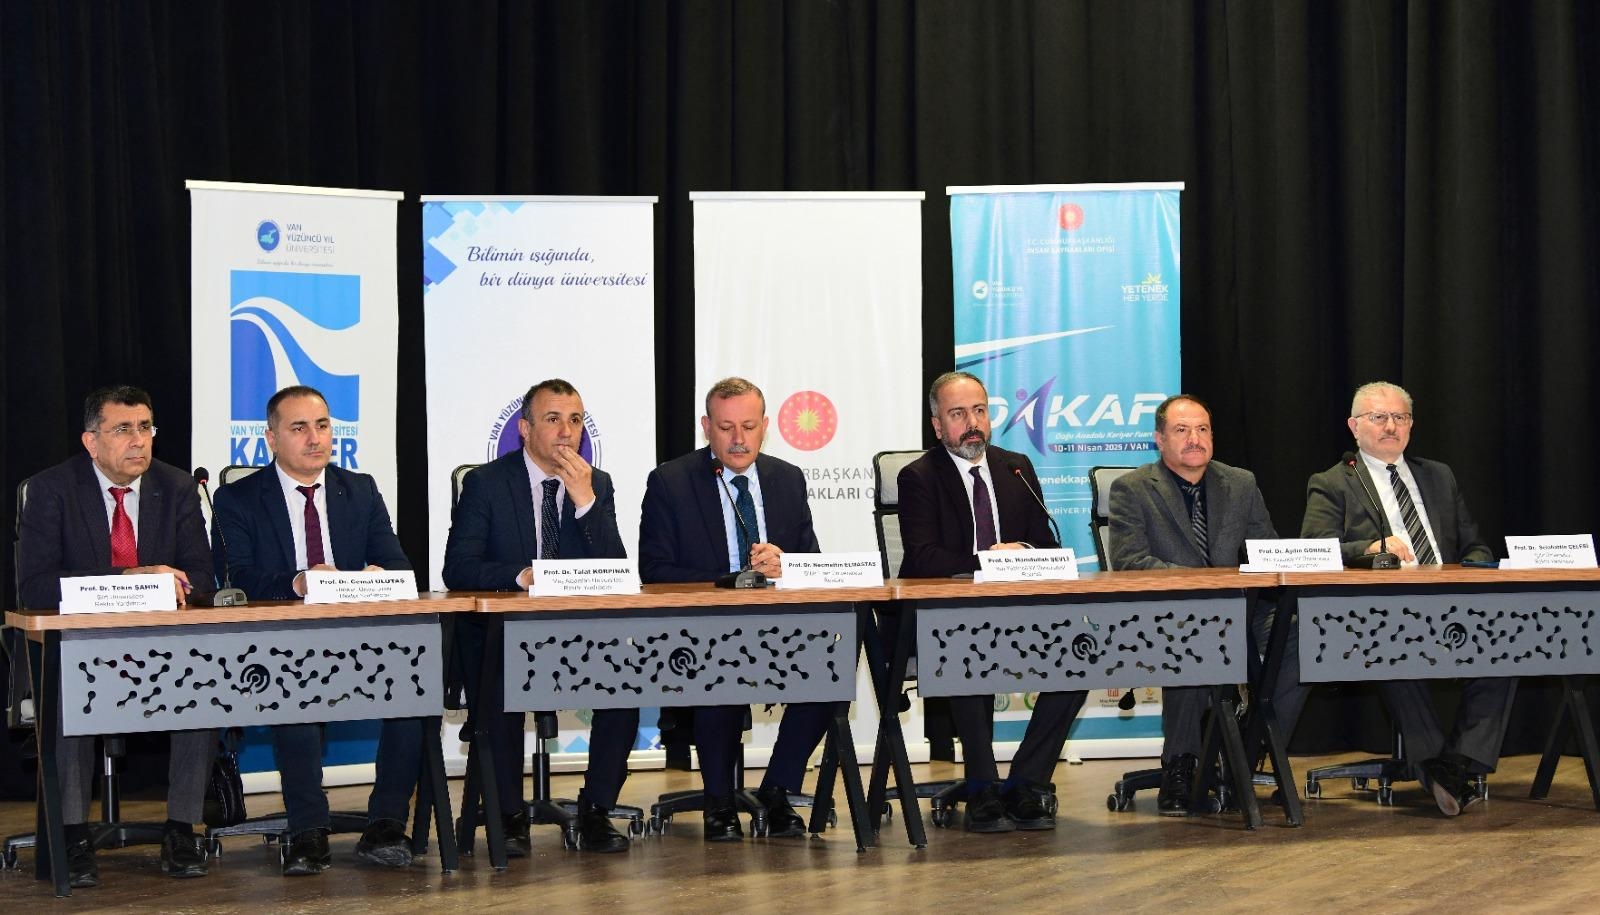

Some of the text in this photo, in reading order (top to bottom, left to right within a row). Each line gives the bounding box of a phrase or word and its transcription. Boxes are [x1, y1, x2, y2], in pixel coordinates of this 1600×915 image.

[286, 223, 302, 232] VAN
[286, 232, 335, 244] YÜZÜNCÜ YIL
[467, 245, 595, 267] Bilimin ışığında,
[479, 272, 648, 289] bir dünya üniversitesi
[1120, 285, 1168, 293] YETENEK
[1123, 294, 1140, 302] HER
[231, 424, 358, 436] VAN YÜZ SİTESİ
[490, 422, 503, 441] VAN
[583, 410, 600, 438] SİTESİ
[1106, 432, 1134, 440] Kariyer
[1053, 444, 1075, 452] 10-11
[1077, 443, 1103, 451] Nisan
[1105, 443, 1123, 451] 2025
[1130, 442, 1149, 450] VAN
[803, 467, 874, 483] RBAŞKAN
[1039, 474, 1090, 485] enekkap
[807, 487, 860, 499] AKLARI
[1047, 507, 1080, 515] ARİYER
